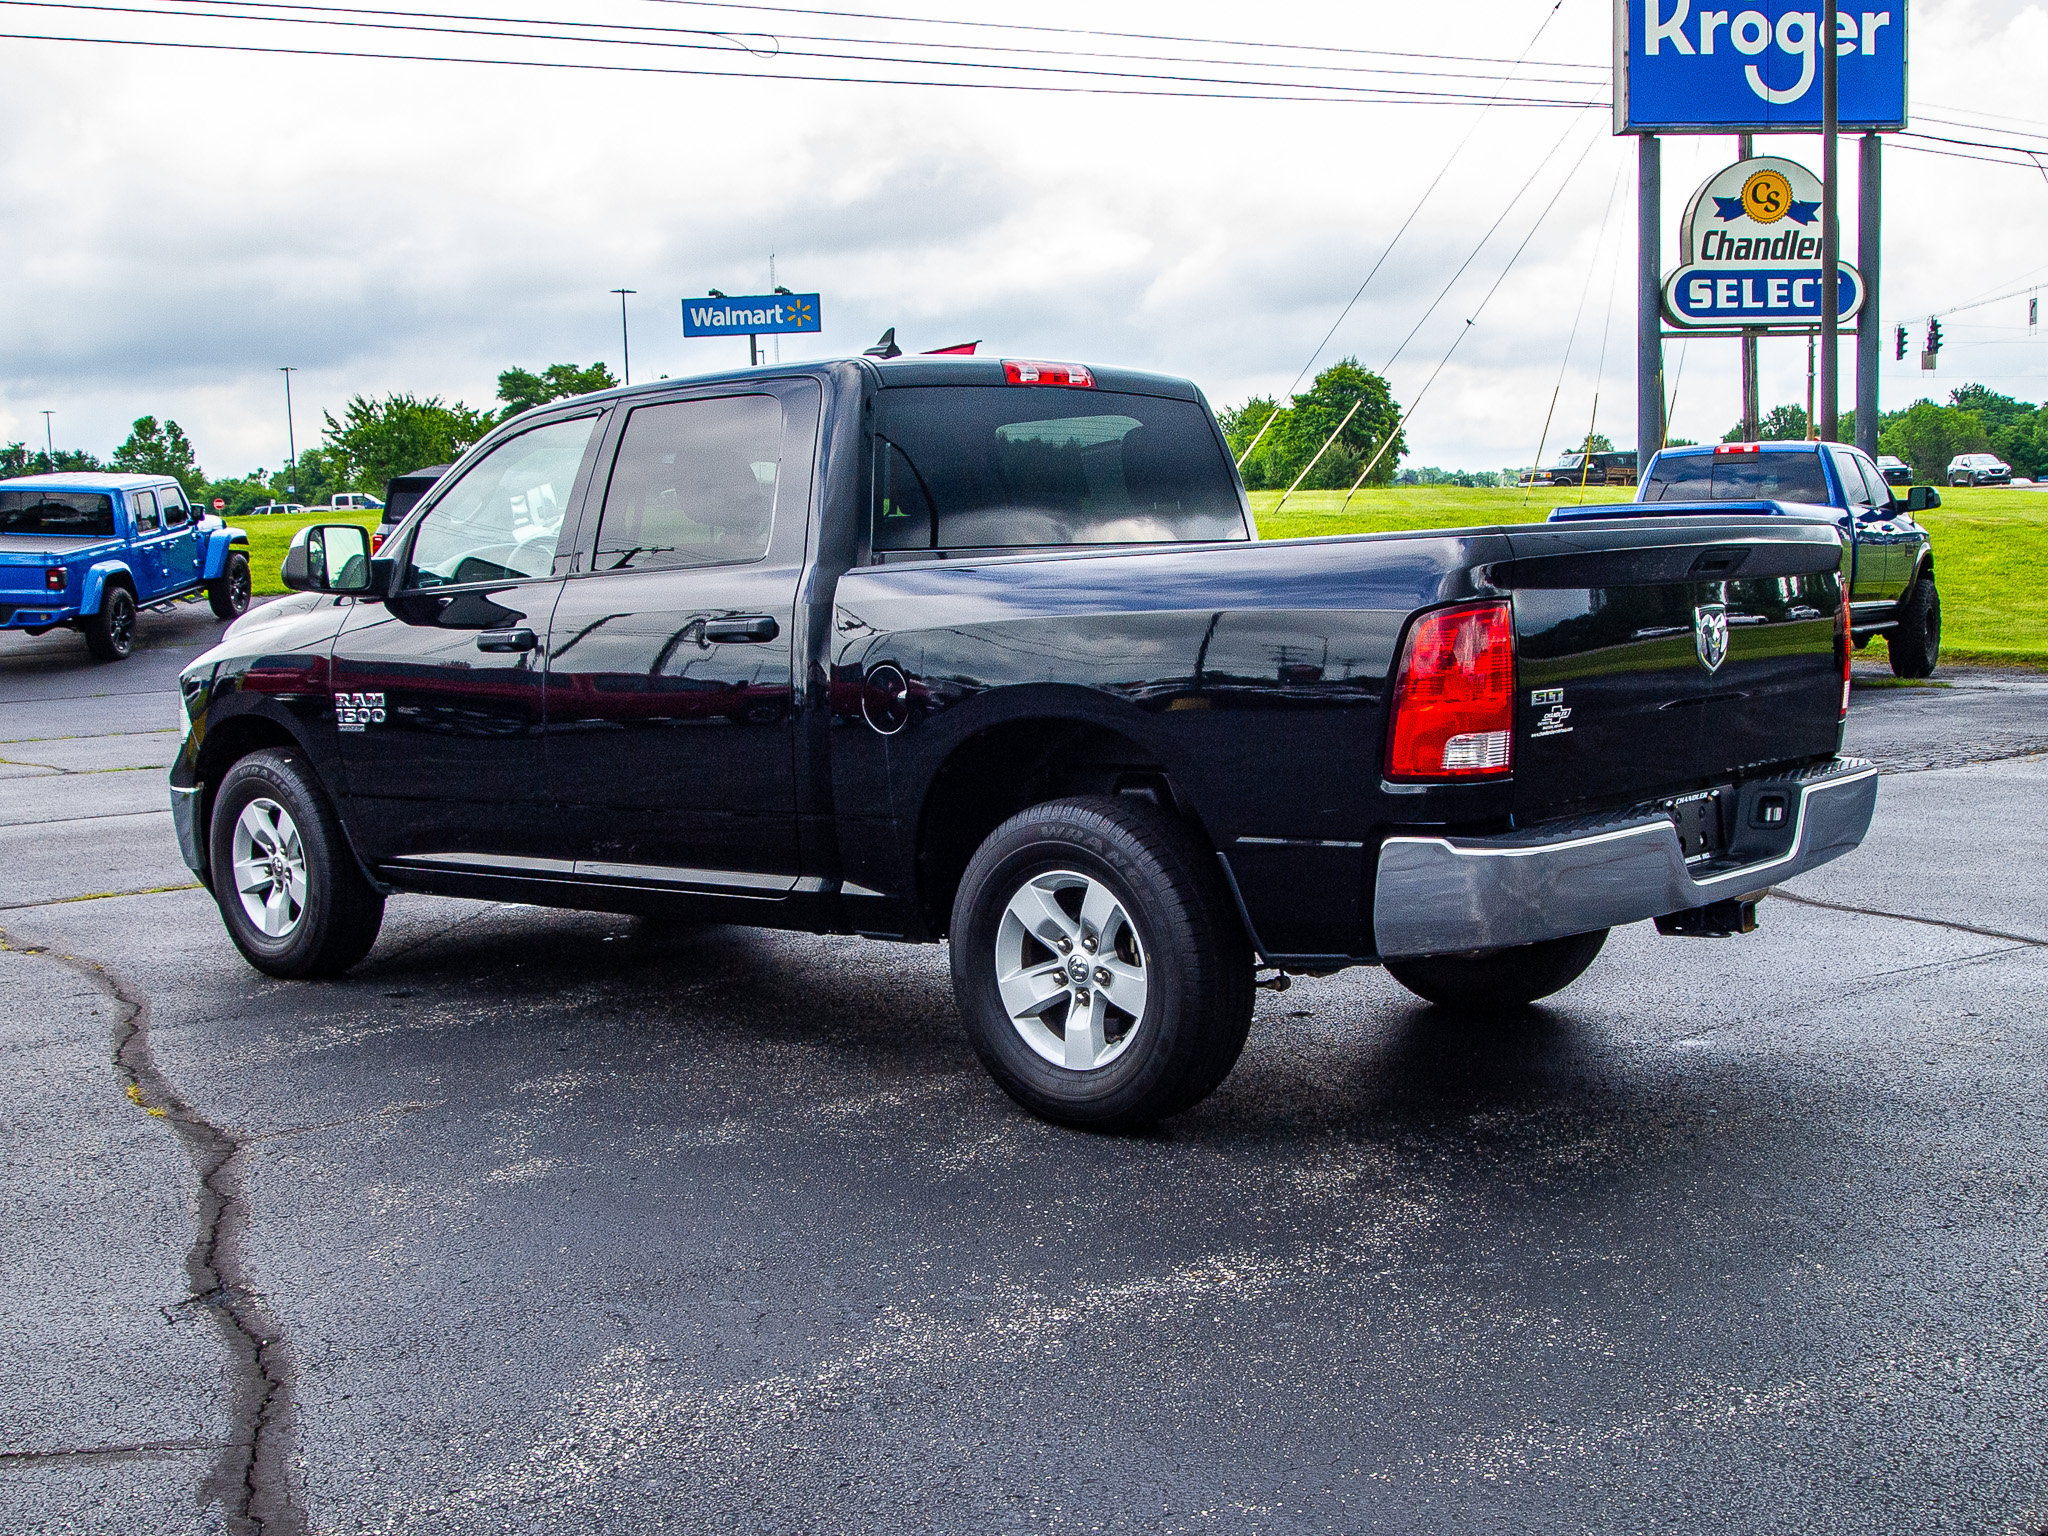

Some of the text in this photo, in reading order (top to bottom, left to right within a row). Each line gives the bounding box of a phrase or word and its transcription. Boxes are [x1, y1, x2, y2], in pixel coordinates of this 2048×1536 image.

[1645, 0, 1890, 105] Kroger
[1752, 182, 1780, 213] CS
[1689, 277, 1842, 309] SELEC
[690, 304, 784, 328] Walmart
[334, 692, 386, 707] RAM
[1532, 689, 1562, 705] SLT
[335, 708, 387, 723] 1500
